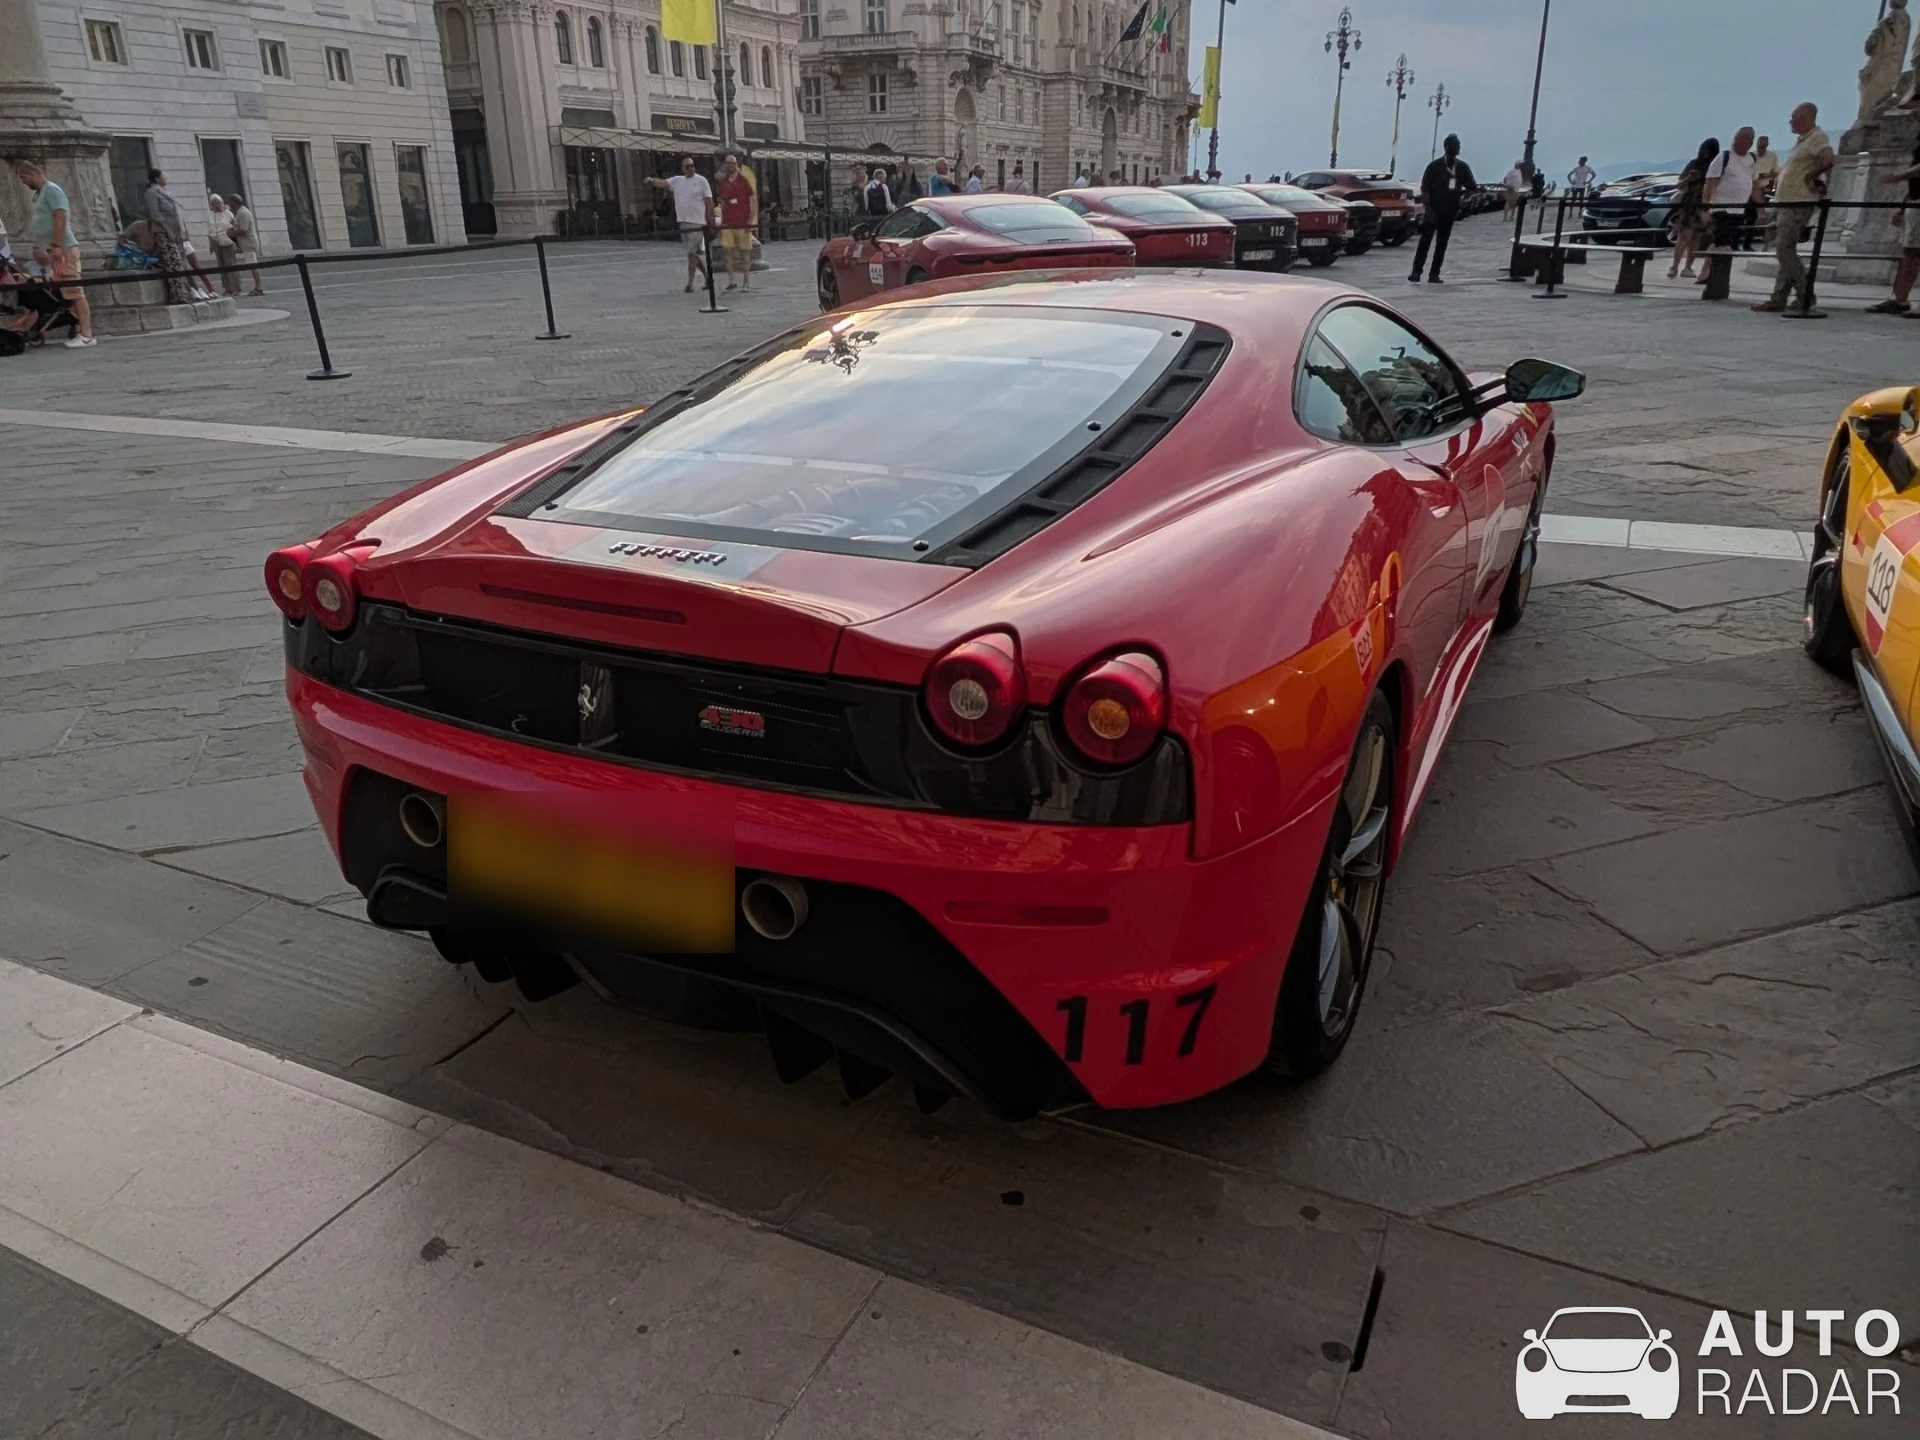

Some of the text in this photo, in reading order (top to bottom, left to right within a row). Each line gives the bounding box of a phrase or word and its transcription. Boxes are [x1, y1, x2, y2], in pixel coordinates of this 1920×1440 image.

[1327, 214, 1339, 225] 111
[1189, 232, 1209, 247] 113
[1270, 226, 1285, 237] 112
[608, 541, 728, 567] Ferrari
[1867, 551, 1896, 615] 118
[699, 704, 765, 731] 430
[700, 719, 766, 738] SCUDERIA
[1056, 983, 1218, 1066] 117
